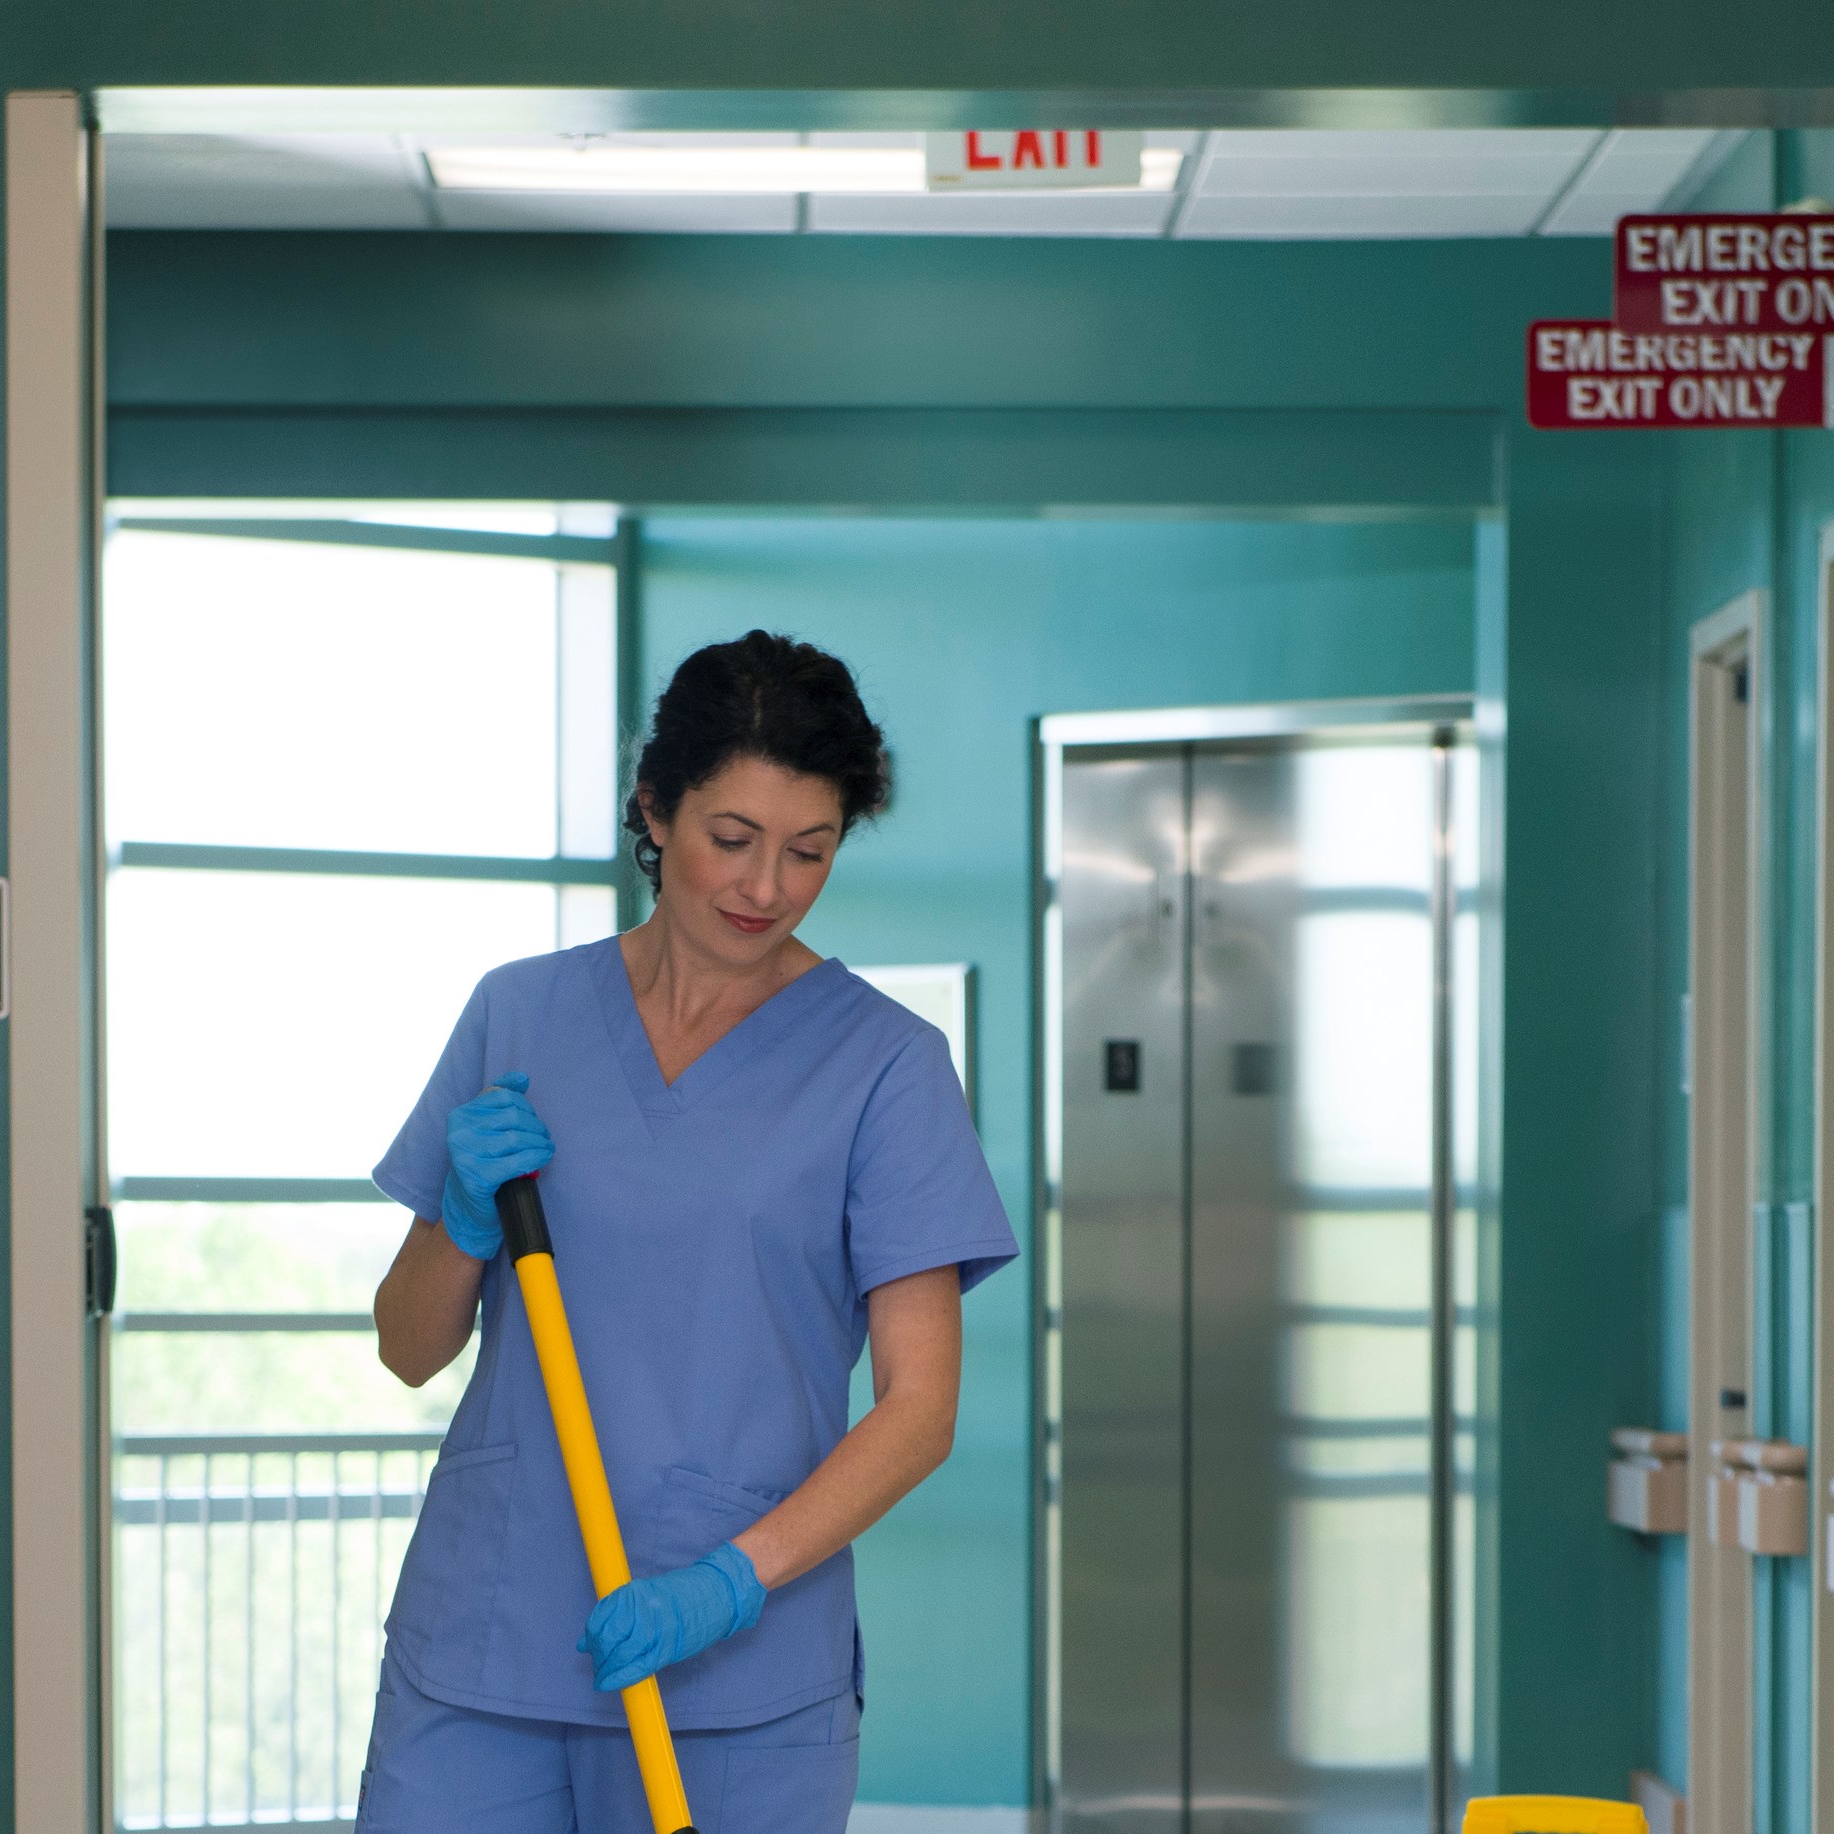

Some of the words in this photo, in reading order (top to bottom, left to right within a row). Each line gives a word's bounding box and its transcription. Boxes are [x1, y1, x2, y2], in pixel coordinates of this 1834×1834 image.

[1661, 279, 1767, 325] EXIT
[1536, 329, 1814, 372] EMERGENCY
[1567, 377, 1664, 419] EXIT
[1669, 376, 1786, 419] ONLY
